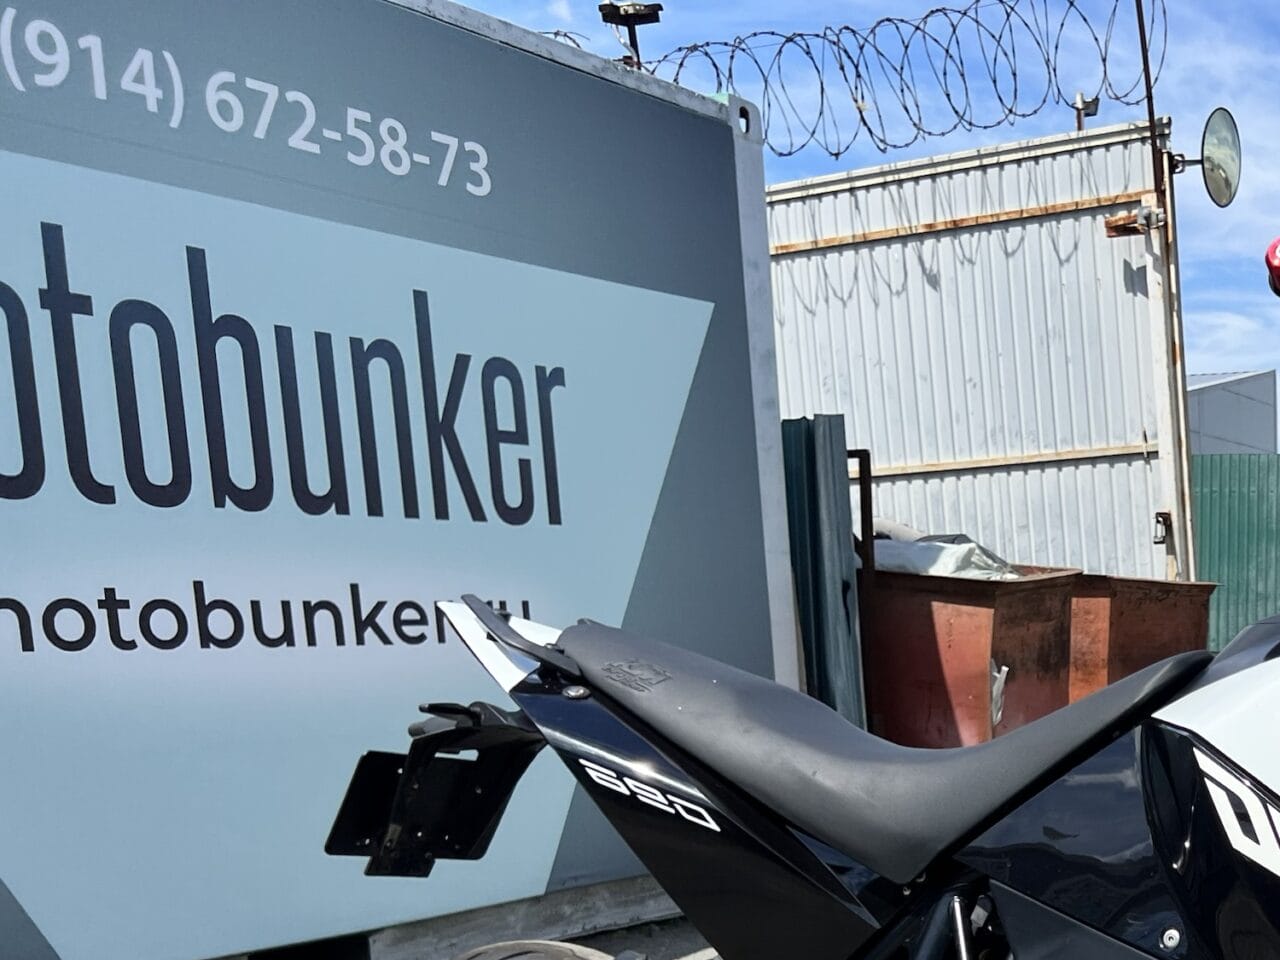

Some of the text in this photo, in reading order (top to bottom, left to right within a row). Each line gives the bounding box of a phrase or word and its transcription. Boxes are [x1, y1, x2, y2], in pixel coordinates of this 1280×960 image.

[0, 7, 493, 196] (914) 672-58-73
[0, 580, 530, 653] otobunker
[578, 758, 721, 832] 690
